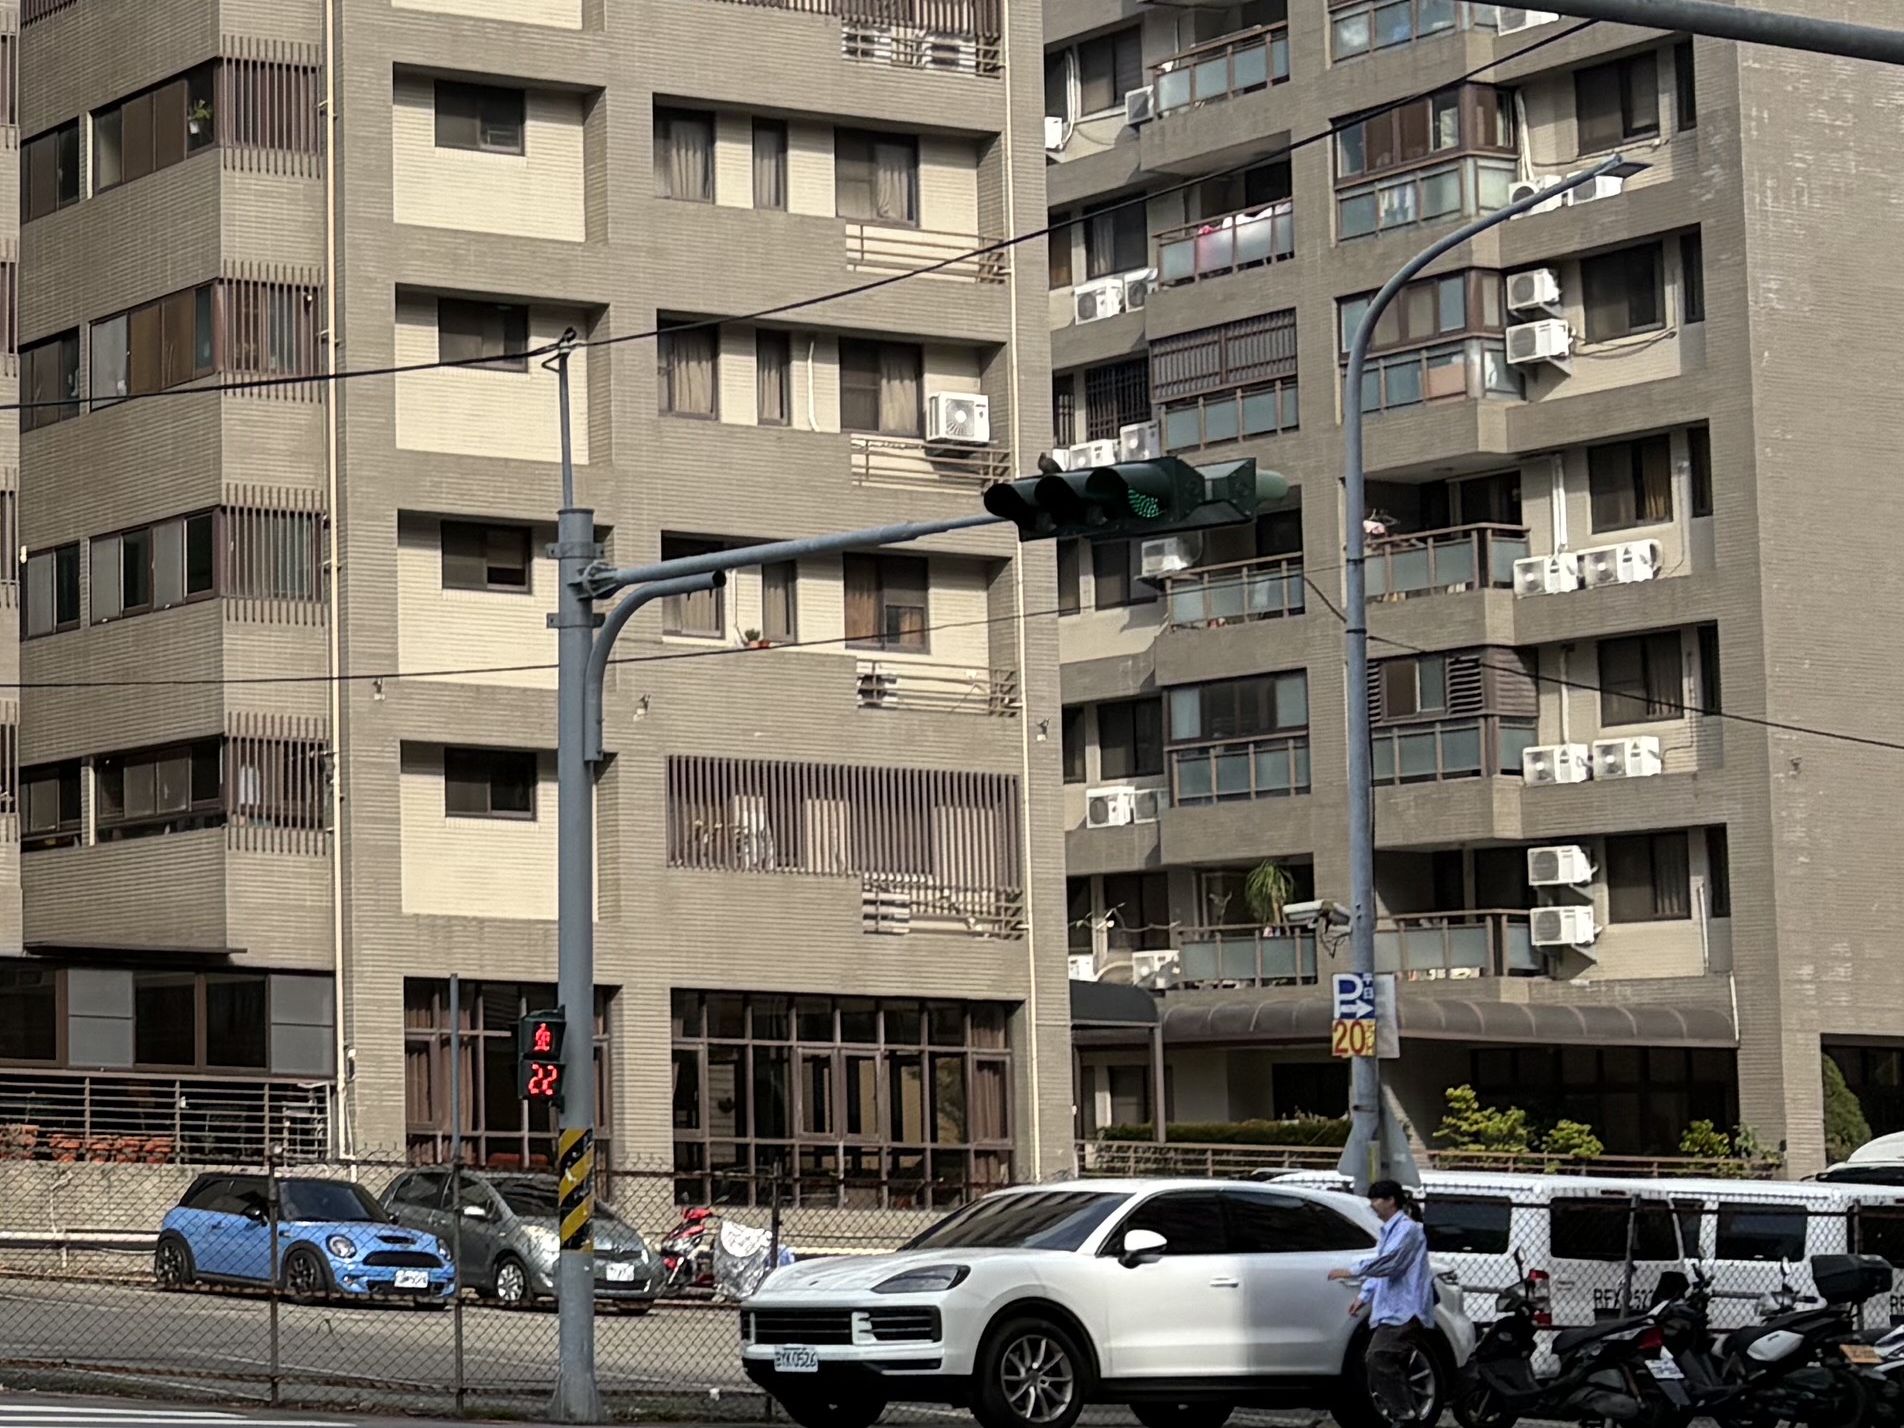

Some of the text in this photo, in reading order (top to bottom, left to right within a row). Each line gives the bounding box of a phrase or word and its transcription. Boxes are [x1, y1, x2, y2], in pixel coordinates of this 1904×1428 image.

[1332, 973, 1364, 1019] P
[1333, 1020, 1366, 1055] 20
[528, 1063, 557, 1095] 22
